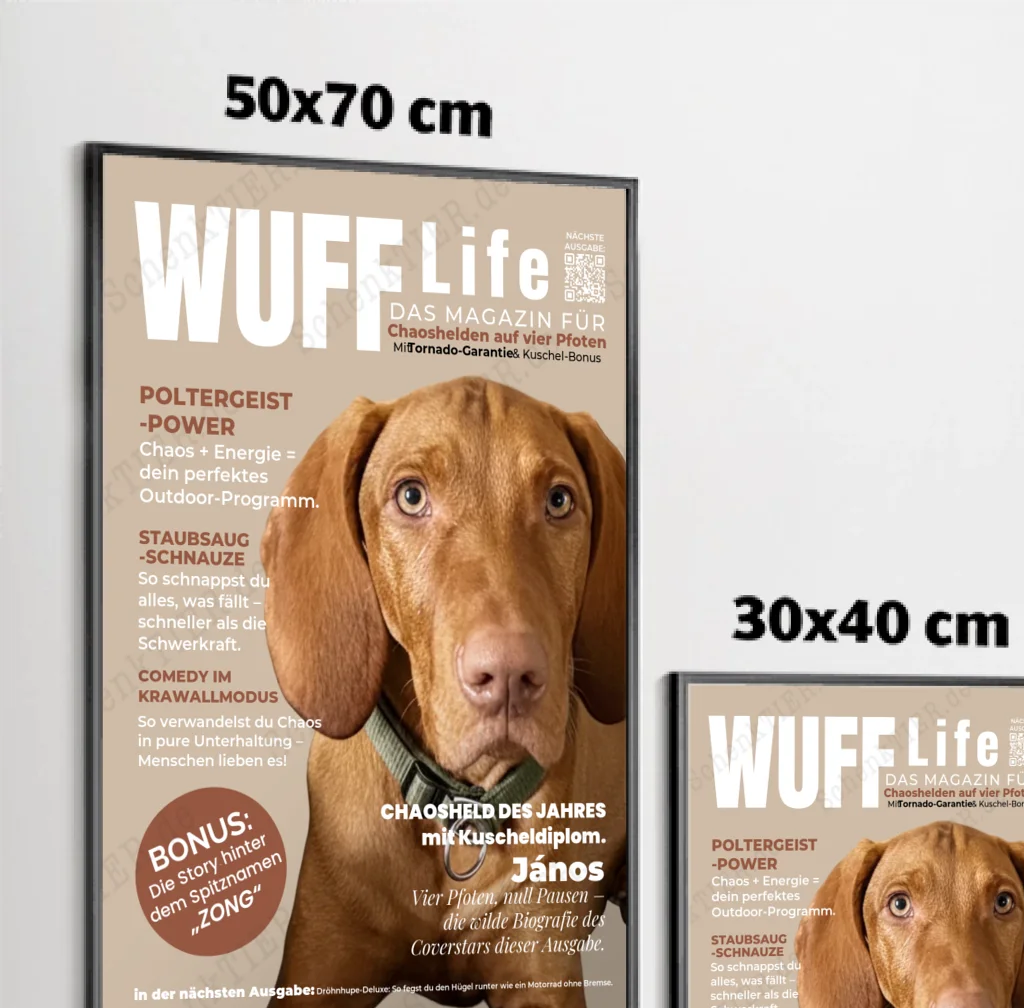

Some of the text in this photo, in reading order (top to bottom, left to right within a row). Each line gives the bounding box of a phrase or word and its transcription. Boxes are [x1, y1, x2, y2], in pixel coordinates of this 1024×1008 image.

[134, 200, 548, 352] WUFF Life
[390, 302, 604, 331] DAS MAGAZIN FÜR
[387, 323, 606, 349] Chaoshelden auf vier Pfoten
[140, 385, 293, 410] POLTERGEIST
[140, 413, 235, 436] -POWER
[139, 440, 194, 459] Chaos
[214, 443, 281, 464] Energie
[139, 463, 268, 486] dein perfektes
[139, 487, 319, 511] Outdoor-Programm.
[139, 529, 249, 547] STAUBSAUG
[139, 549, 245, 566] -SCHNAUZE
[138, 571, 269, 590] So schnappst du
[138, 592, 178, 609] alles,
[182, 596, 214, 608] was
[218, 593, 248, 608] fällt
[138, 614, 266, 630] schneller als die
[138, 636, 241, 651] Schwerkraft.
[138, 669, 231, 683] COMEDY IM
[138, 689, 278, 703] KRAWALLMODUS
[138, 715, 321, 728] So verwandelst du Chaos
[138, 733, 151, 747] in
[156, 736, 190, 749] pure
[194, 733, 292, 749] Unterhaltung
[138, 753, 287, 767] Menschen lieben es!
[708, 715, 998, 809] WUFF Life
[885, 773, 918, 786] DAS
[924, 772, 999, 786] MAGAZIN
[883, 787, 955, 798] Chaoshelden
[958, 787, 977, 797] auf
[979, 787, 1000, 797] vier
[380, 802, 606, 820] CHAOSHELD DES JAHRES
[148, 811, 252, 872] BONUS:
[422, 826, 606, 851] mit Kuscheldiplom.
[712, 837, 817, 852] POLTERGEIST
[148, 834, 266, 899] Die Story hinter
[511, 853, 604, 882] János
[711, 857, 777, 870] -POWER
[149, 852, 282, 922] dem Spitznamen
[412, 888, 443, 906] Vier
[446, 887, 498, 907] Pfoten,
[503, 887, 533, 905] null
[536, 886, 588, 904] Pausen
[443, 910, 605, 932] die wilde Biografie des
[410, 934, 604, 957] Coverstars dieser Ausgabe.
[711, 933, 787, 945] STAUBSAUG
[711, 946, 784, 958] -SCHNAUZE
[134, 987, 147, 1001] in
[151, 988, 175, 1000] der
[179, 984, 245, 999] nächsten
[249, 983, 314, 1000] Ausgabe:
